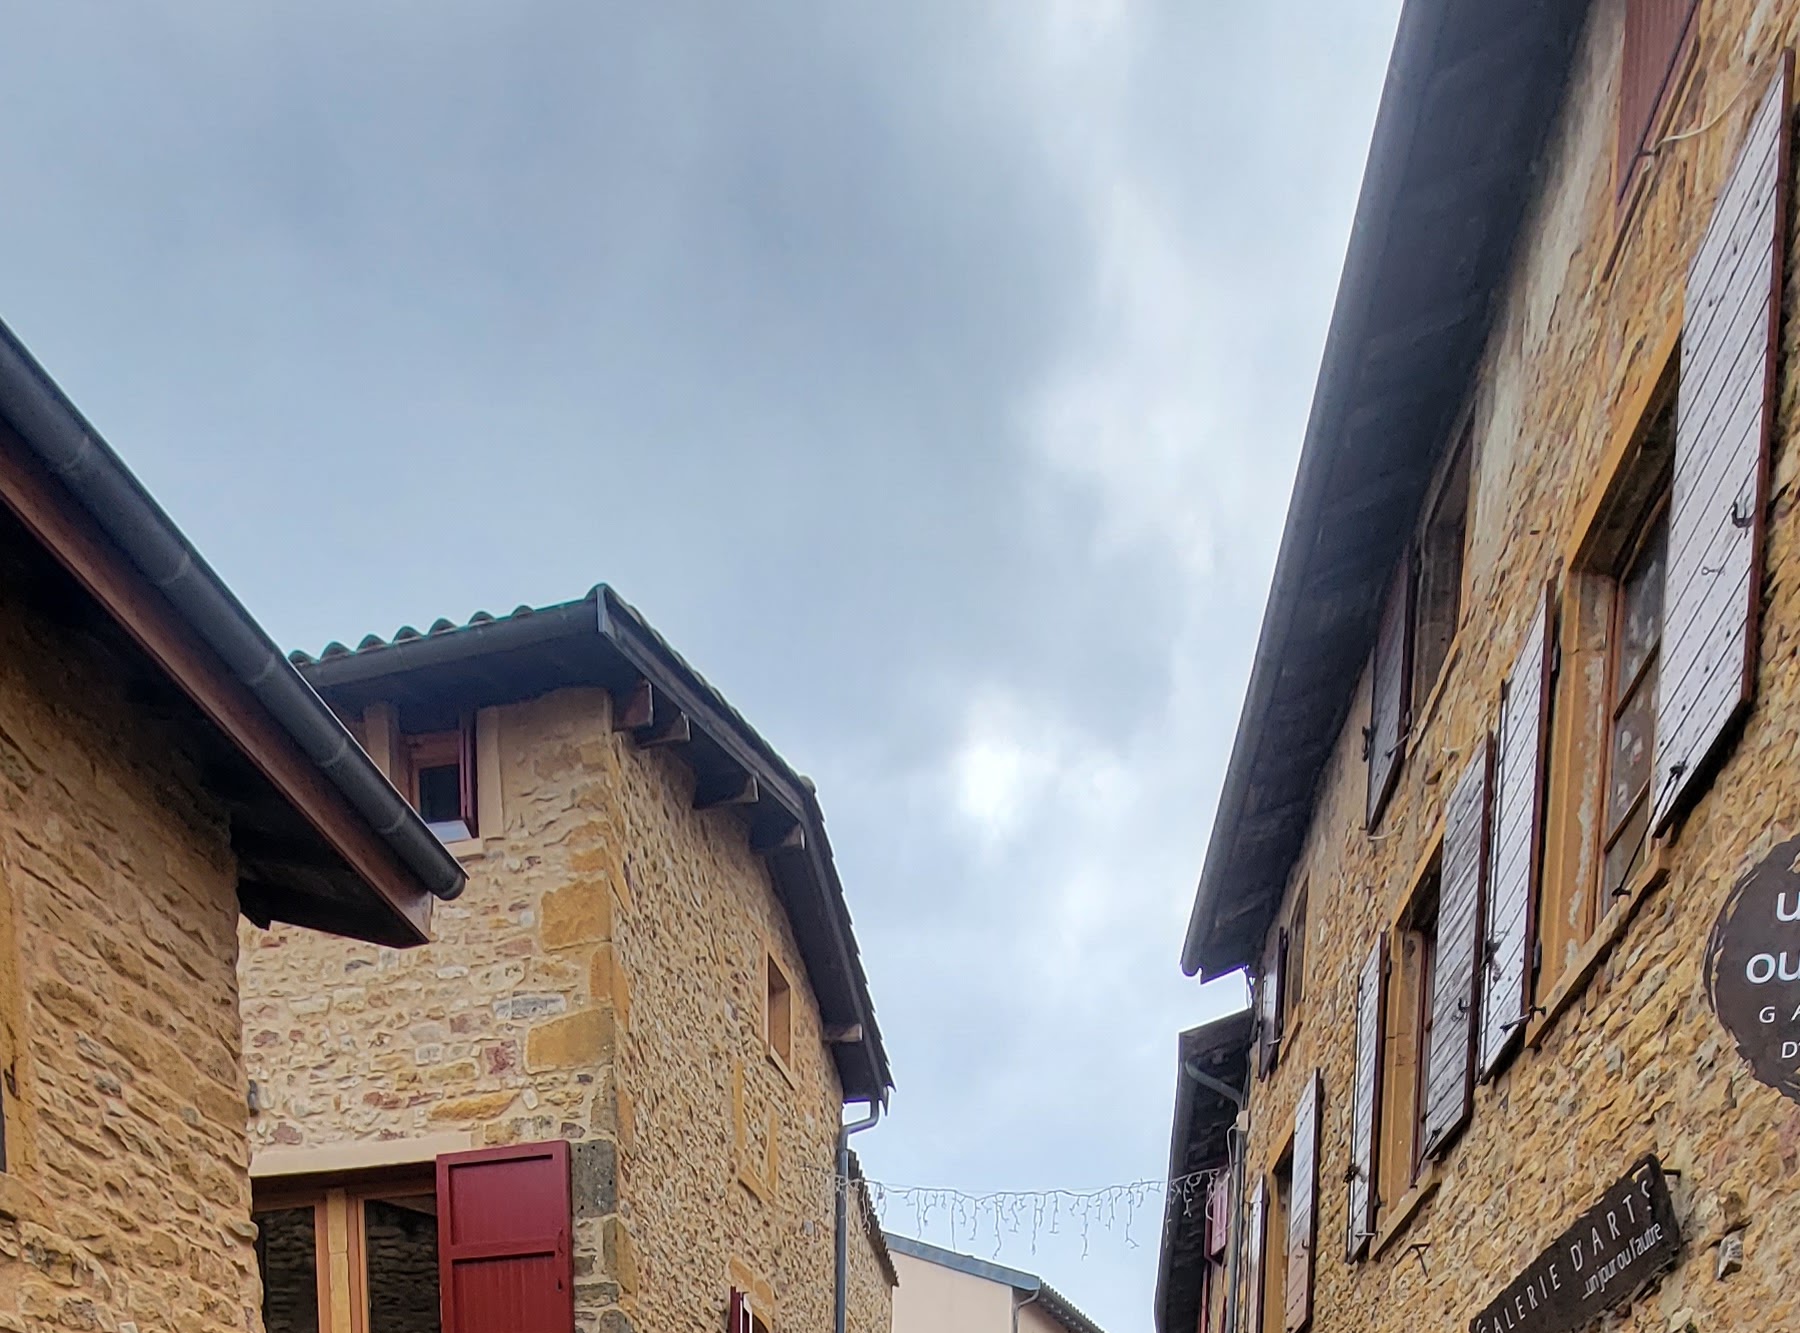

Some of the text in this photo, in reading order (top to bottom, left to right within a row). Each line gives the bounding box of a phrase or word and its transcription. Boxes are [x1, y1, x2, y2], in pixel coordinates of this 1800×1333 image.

[1781, 1041, 1800, 1059] D
[1596, 1258, 1617, 1293] jour
[1617, 1248, 1632, 1270] ou
[1629, 1223, 1663, 1260] l'autre
